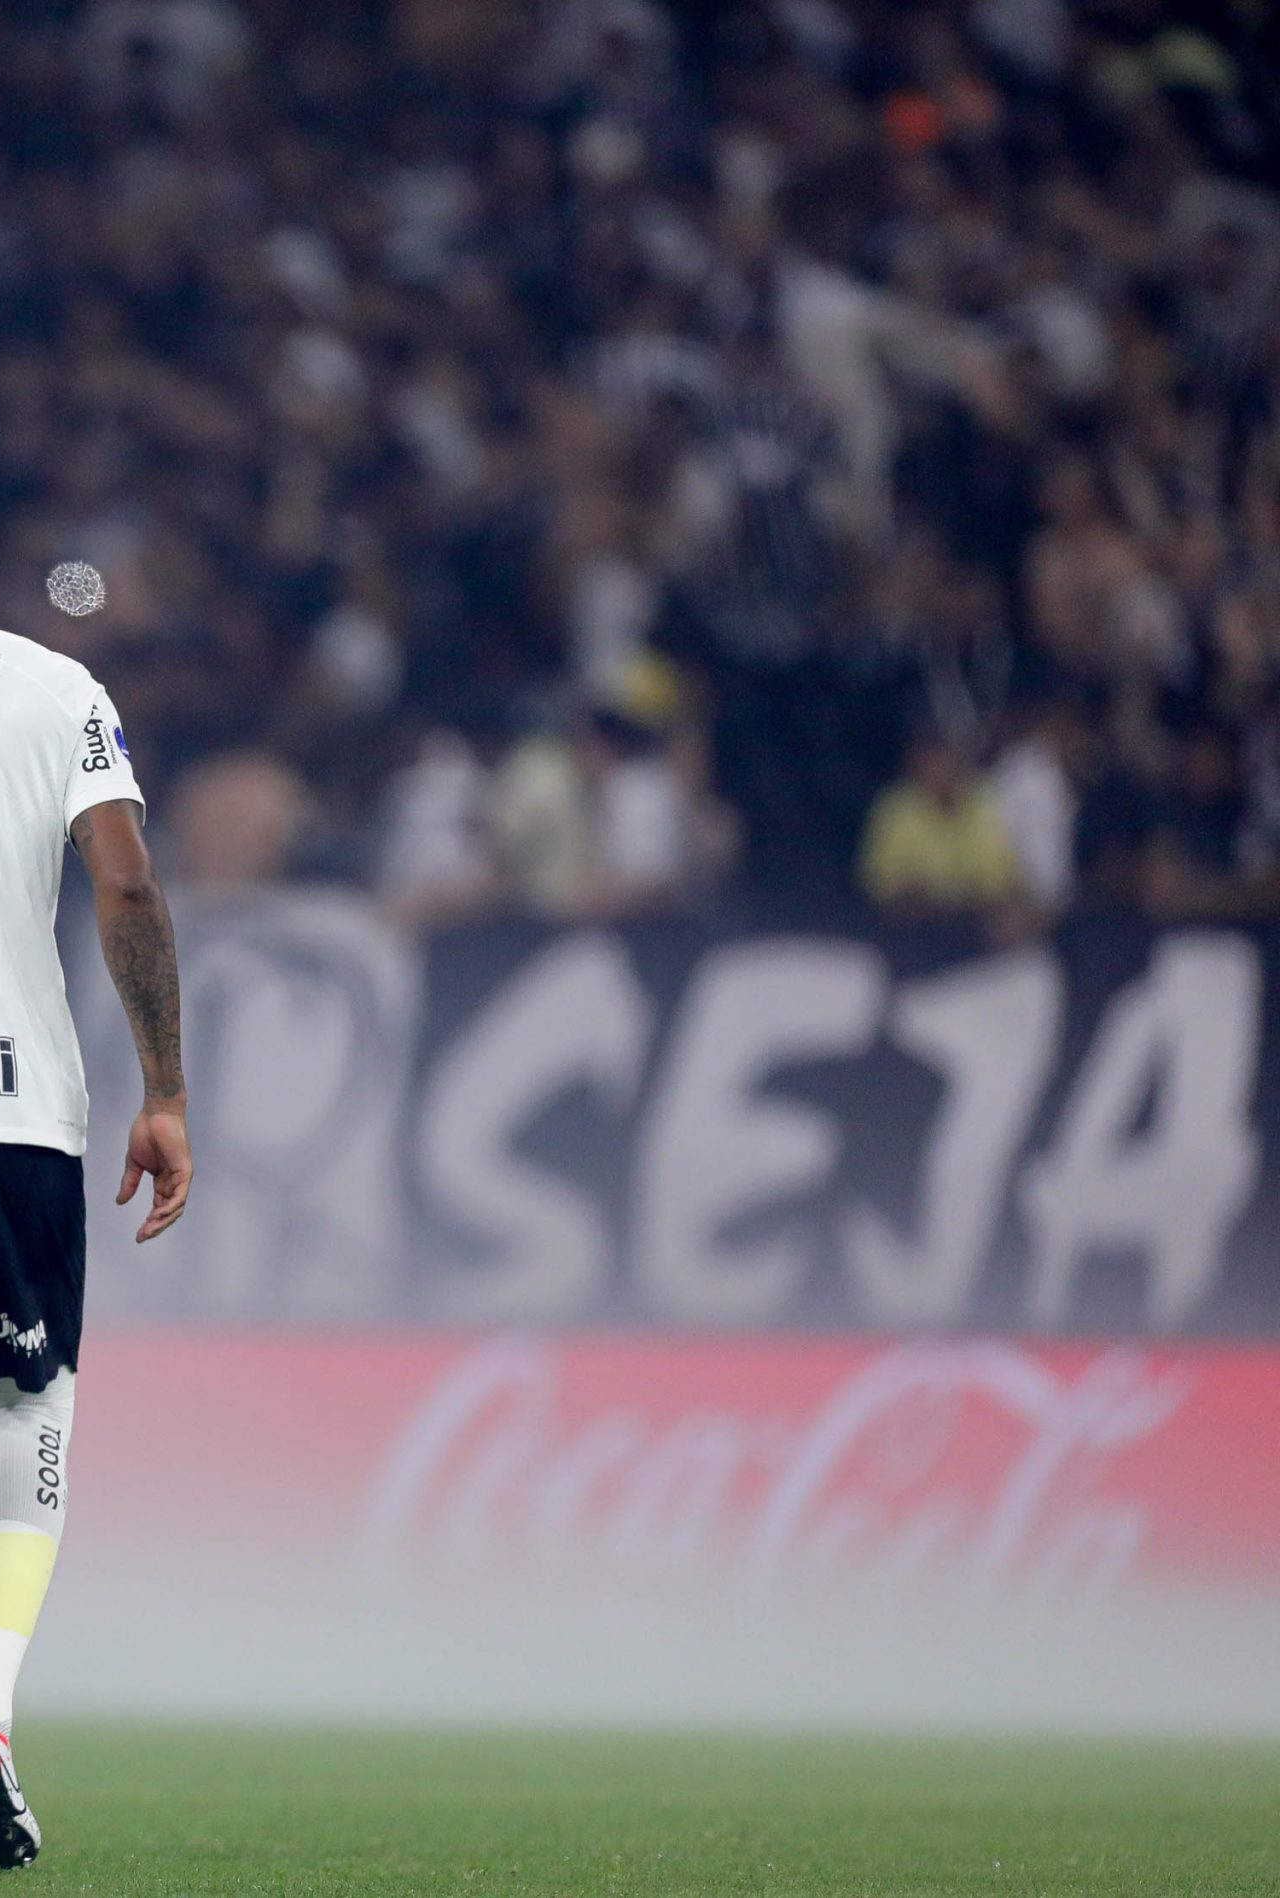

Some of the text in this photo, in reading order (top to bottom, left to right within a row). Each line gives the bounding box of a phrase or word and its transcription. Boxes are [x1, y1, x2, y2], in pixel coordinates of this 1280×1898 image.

[81, 718, 111, 773] bmg
[415, 928, 1265, 1332] SEJA
[36, 1424, 61, 1510] TODOS
